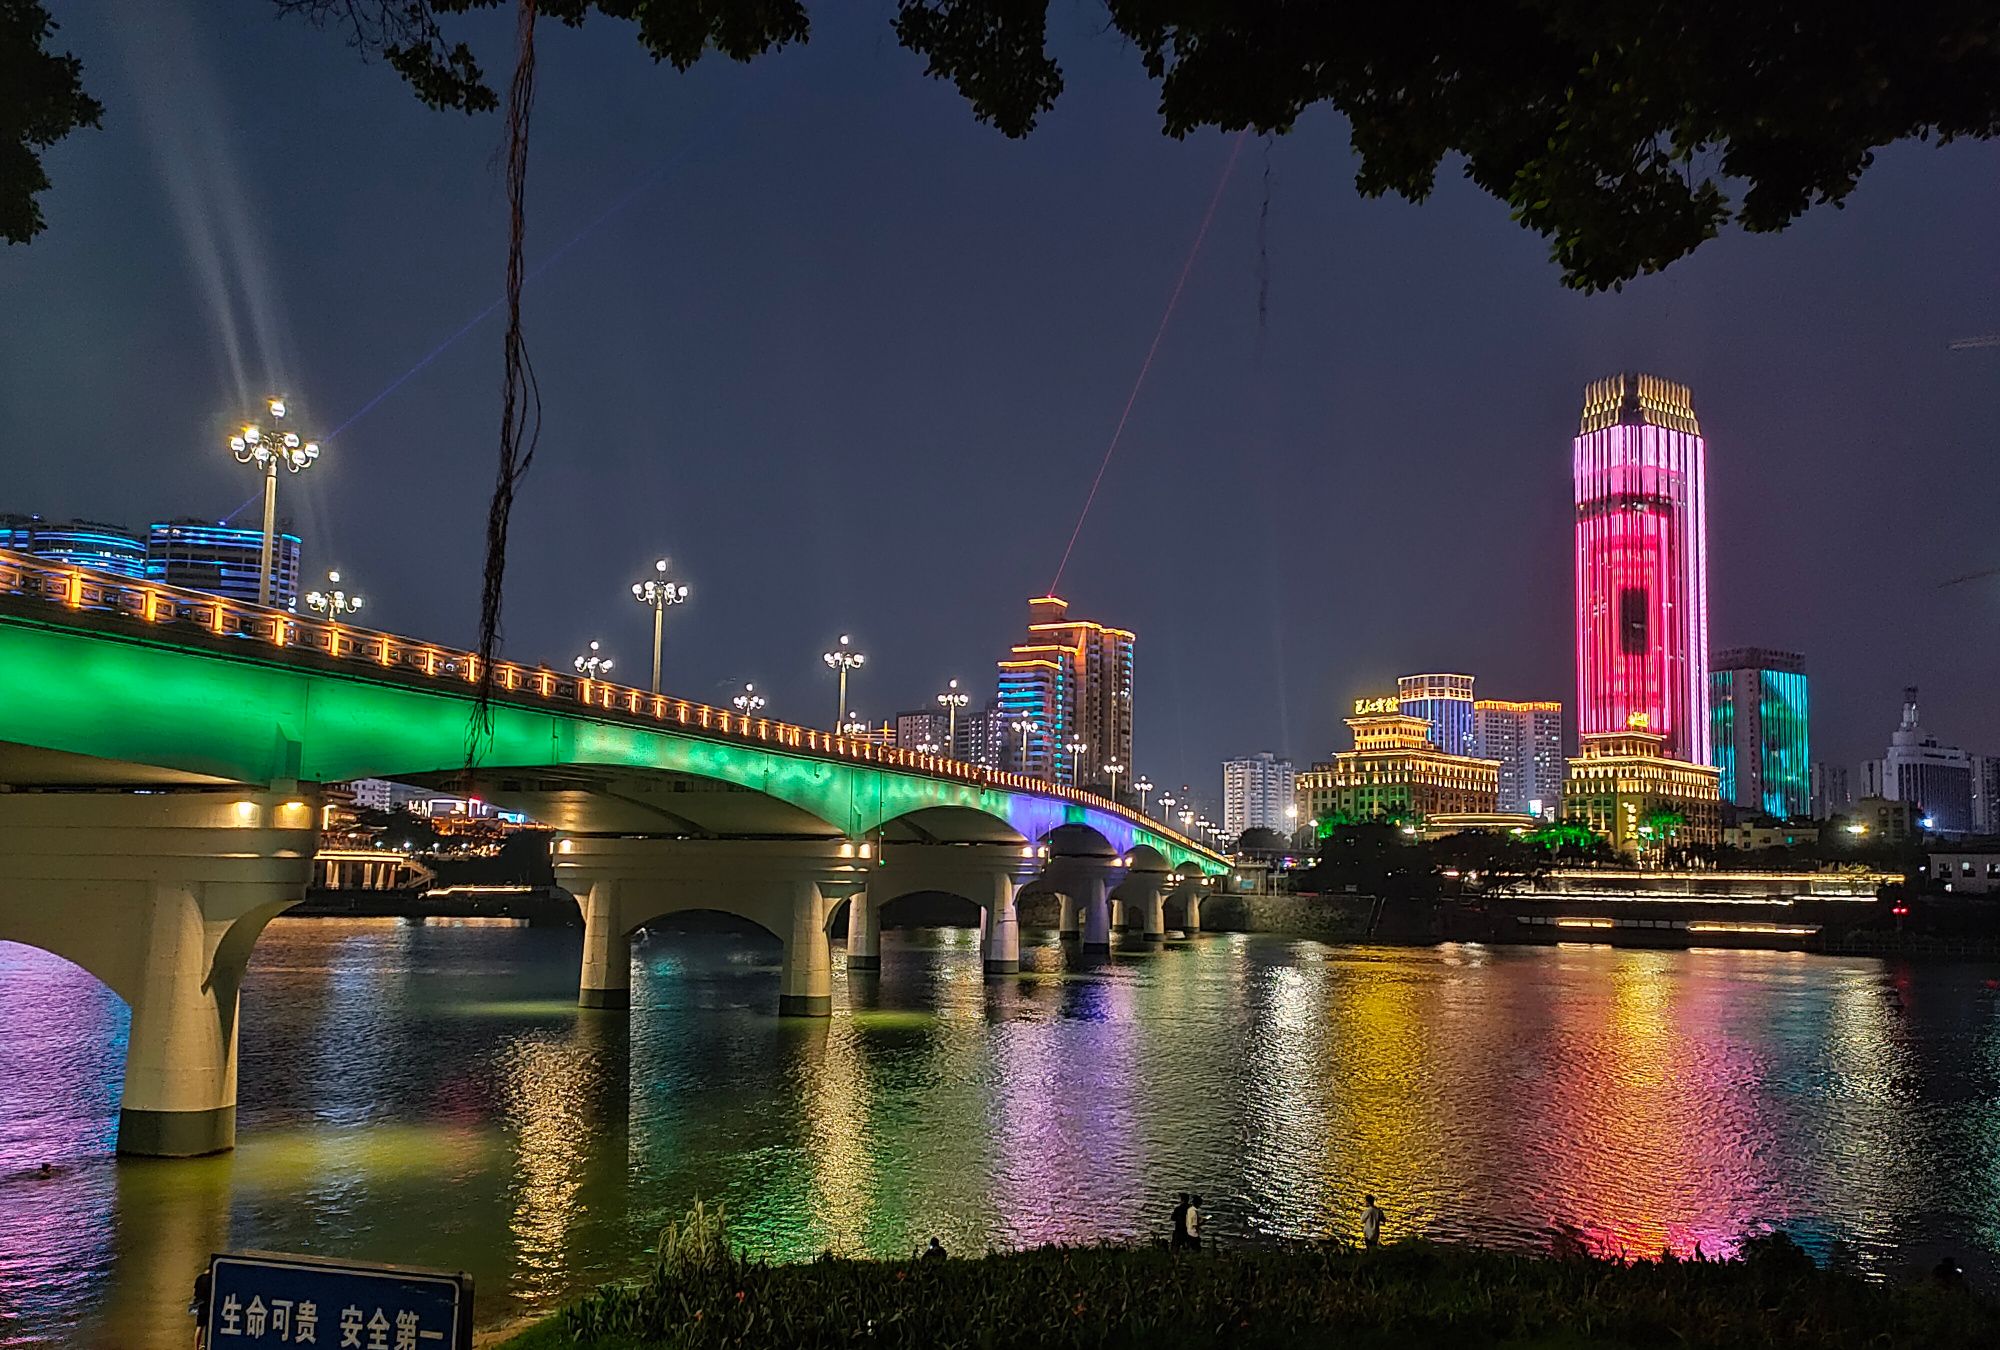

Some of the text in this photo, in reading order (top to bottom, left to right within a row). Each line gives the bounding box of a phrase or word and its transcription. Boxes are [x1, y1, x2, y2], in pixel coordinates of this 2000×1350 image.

[220, 1292, 444, 1350] 生命可贵 安全第一
